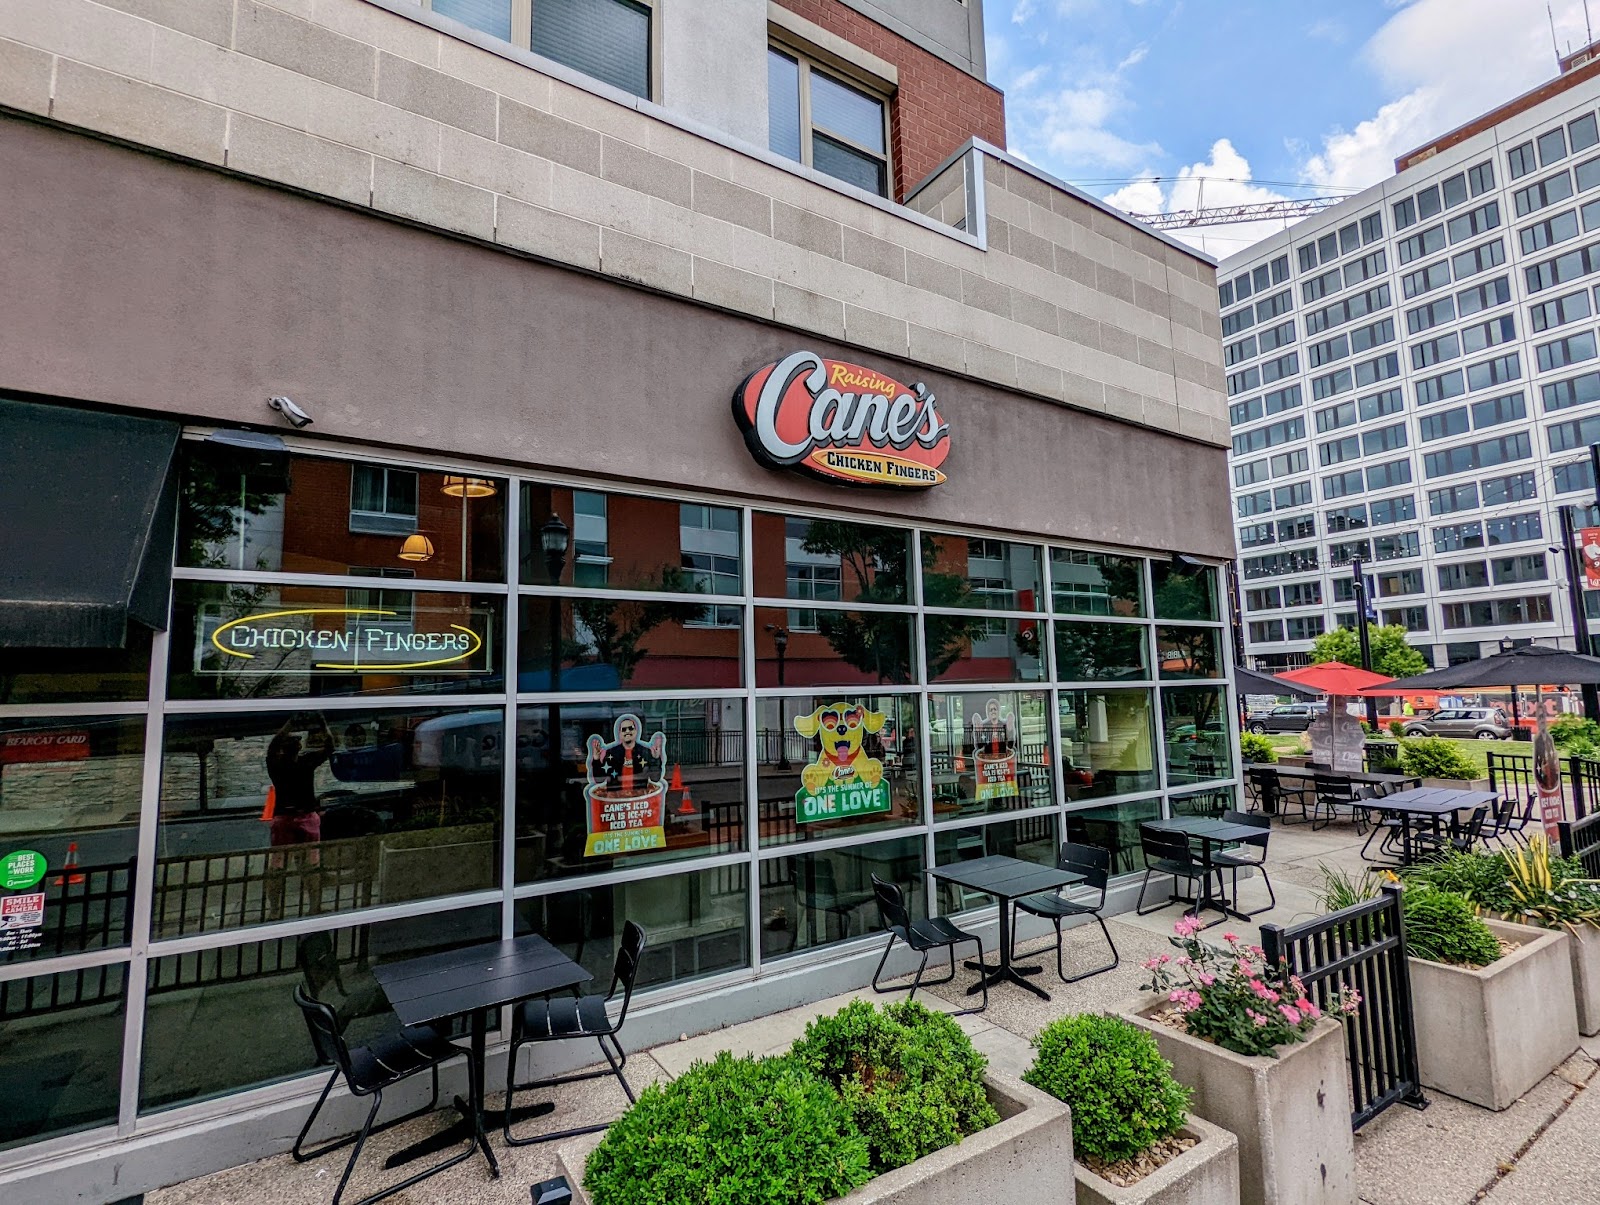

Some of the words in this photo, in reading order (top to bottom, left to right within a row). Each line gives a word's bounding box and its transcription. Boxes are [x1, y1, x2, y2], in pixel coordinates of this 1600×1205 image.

[830, 364, 896, 399] Raising
[756, 351, 949, 459] Cane's
[827, 451, 882, 473] CHICKEN
[886, 461, 936, 481] FINGERS
[231, 625, 353, 652] CHICKEN
[364, 628, 470, 652] FINGERS
[57, 736, 86, 745] CARD
[815, 785, 826, 794] IT'S
[828, 784, 839, 793] THE
[840, 781, 864, 791] SUMMER
[865, 780, 873, 789] OF
[604, 803, 631, 813] CANE'S
[633, 802, 649, 810] ICED
[804, 794, 837, 816] ONE
[842, 788, 881, 812] LOVE
[601, 814, 615, 822] TEA
[618, 812, 626, 820] IS
[628, 810, 652, 820] ICE-T'S
[610, 821, 626, 830] ICED
[628, 819, 643, 828] TEA
[594, 839, 620, 855] ONE
[625, 835, 658, 851] LOVE
[17, 853, 35, 862] BEST
[8, 860, 35, 869] PLACES
[14, 867, 35, 875] WORK
[7, 896, 40, 906] SMILE
[5, 905, 38, 914] CAMERA
